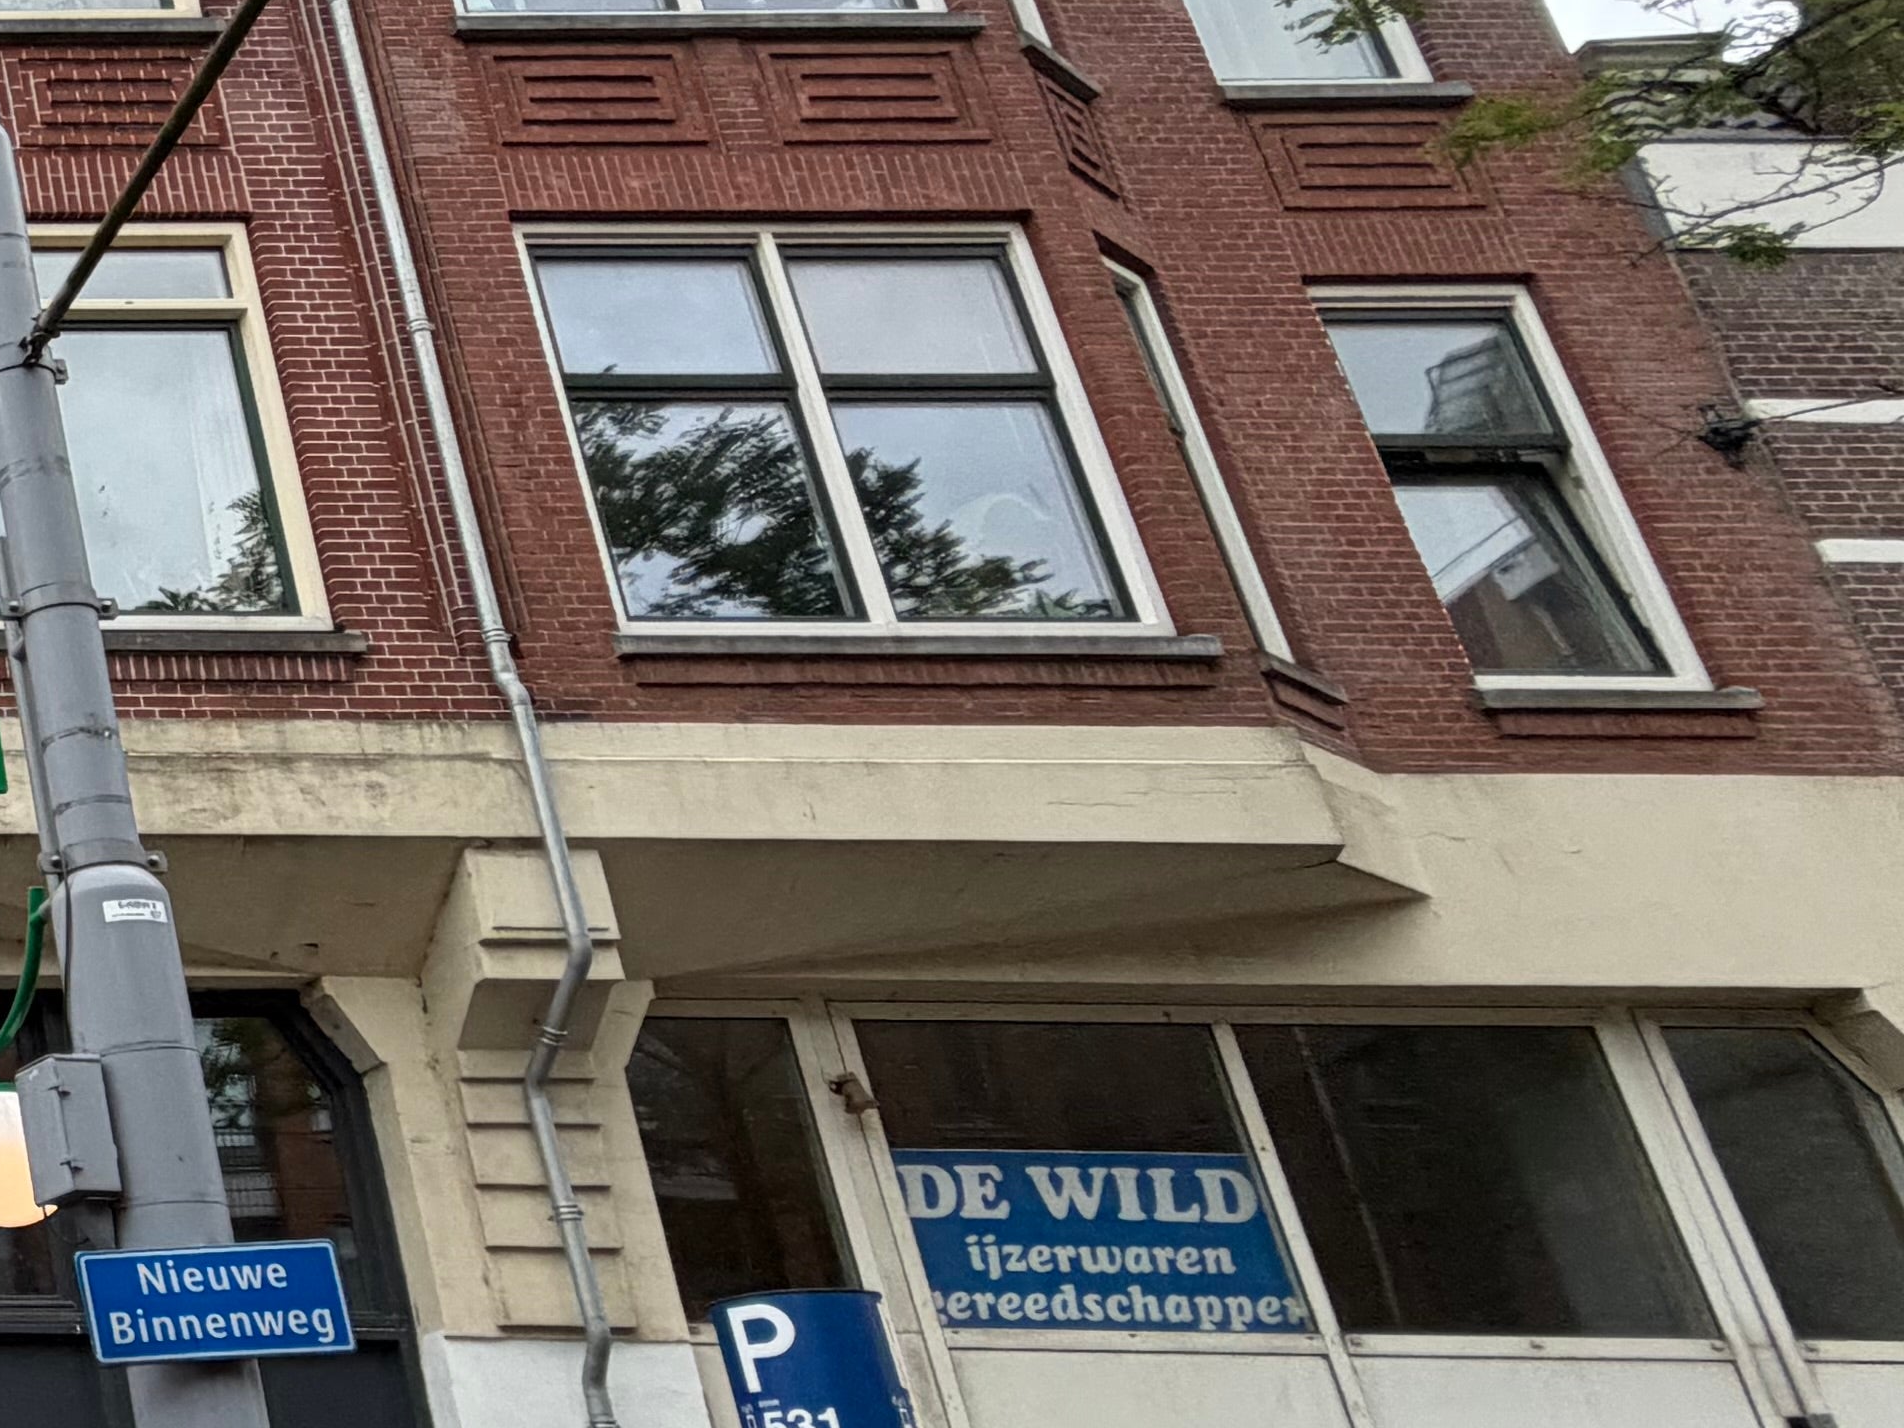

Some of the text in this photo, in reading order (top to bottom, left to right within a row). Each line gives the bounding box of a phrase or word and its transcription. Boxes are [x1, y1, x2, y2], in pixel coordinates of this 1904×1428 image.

[896, 1163, 1259, 1224] DE WILD
[136, 1259, 288, 1296] Nieuwe
[964, 1234, 1237, 1281] ijzerwaren
[108, 1307, 336, 1345] Binnenweg
[726, 1303, 796, 1393] P
